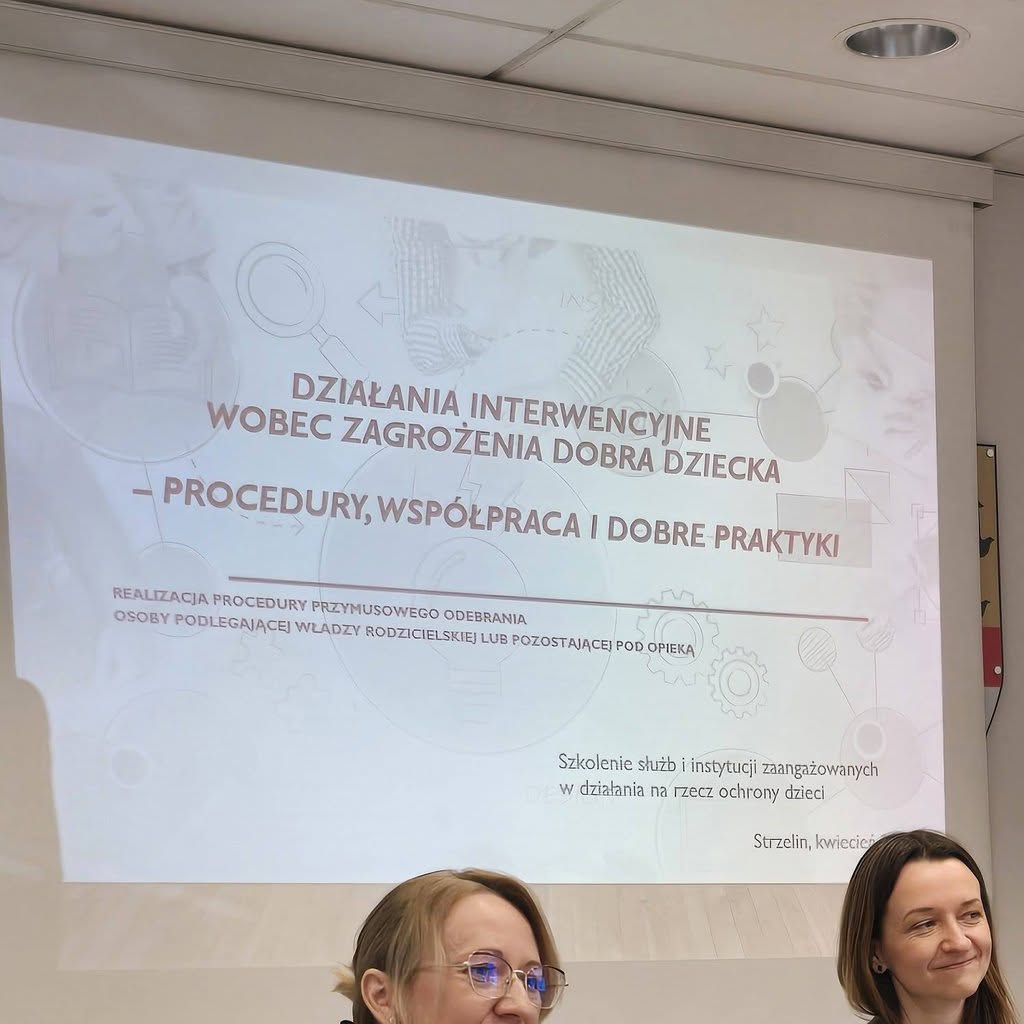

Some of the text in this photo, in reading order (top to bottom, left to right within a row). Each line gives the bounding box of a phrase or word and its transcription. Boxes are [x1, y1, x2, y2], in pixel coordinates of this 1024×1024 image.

[292, 372, 711, 445] DZIAŁANIA INTERWENCYJNE
[207, 400, 781, 483] WOBEC ZAGROŻENIA DOBRA DZIECKA
[163, 476, 371, 525] PROCEDURY,
[377, 495, 580, 539] WSPÓŁPRACA
[590, 514, 598, 539] I
[608, 515, 706, 548] DOBRE
[714, 524, 840, 557] PRAKTYKI
[112, 586, 527, 625] REALIZACJA PROCEDURY PRZYMUSOWEGO ODEBRANIA
[114, 609, 170, 625] OSOBY
[175, 613, 291, 634] PODLEGAJĄCEJ
[295, 620, 360, 637] WŁADZY
[365, 625, 477, 645] RODZICIELSKIEJ
[481, 632, 509, 645] LUB
[512, 634, 613, 653] POZOSTAJĄCEJ
[616, 640, 644, 652] POD
[558, 753, 879, 780] Szkolenie służb i instytucji zaangażowanych
[560, 782, 574, 795] w
[580, 779, 645, 798] działania
[651, 785, 668, 798] na
[674, 785, 714, 799] rzecz
[719, 782, 780, 804] ochrony
[784, 784, 825, 801] dzieci
[753, 833, 812, 851] Strzelin,
